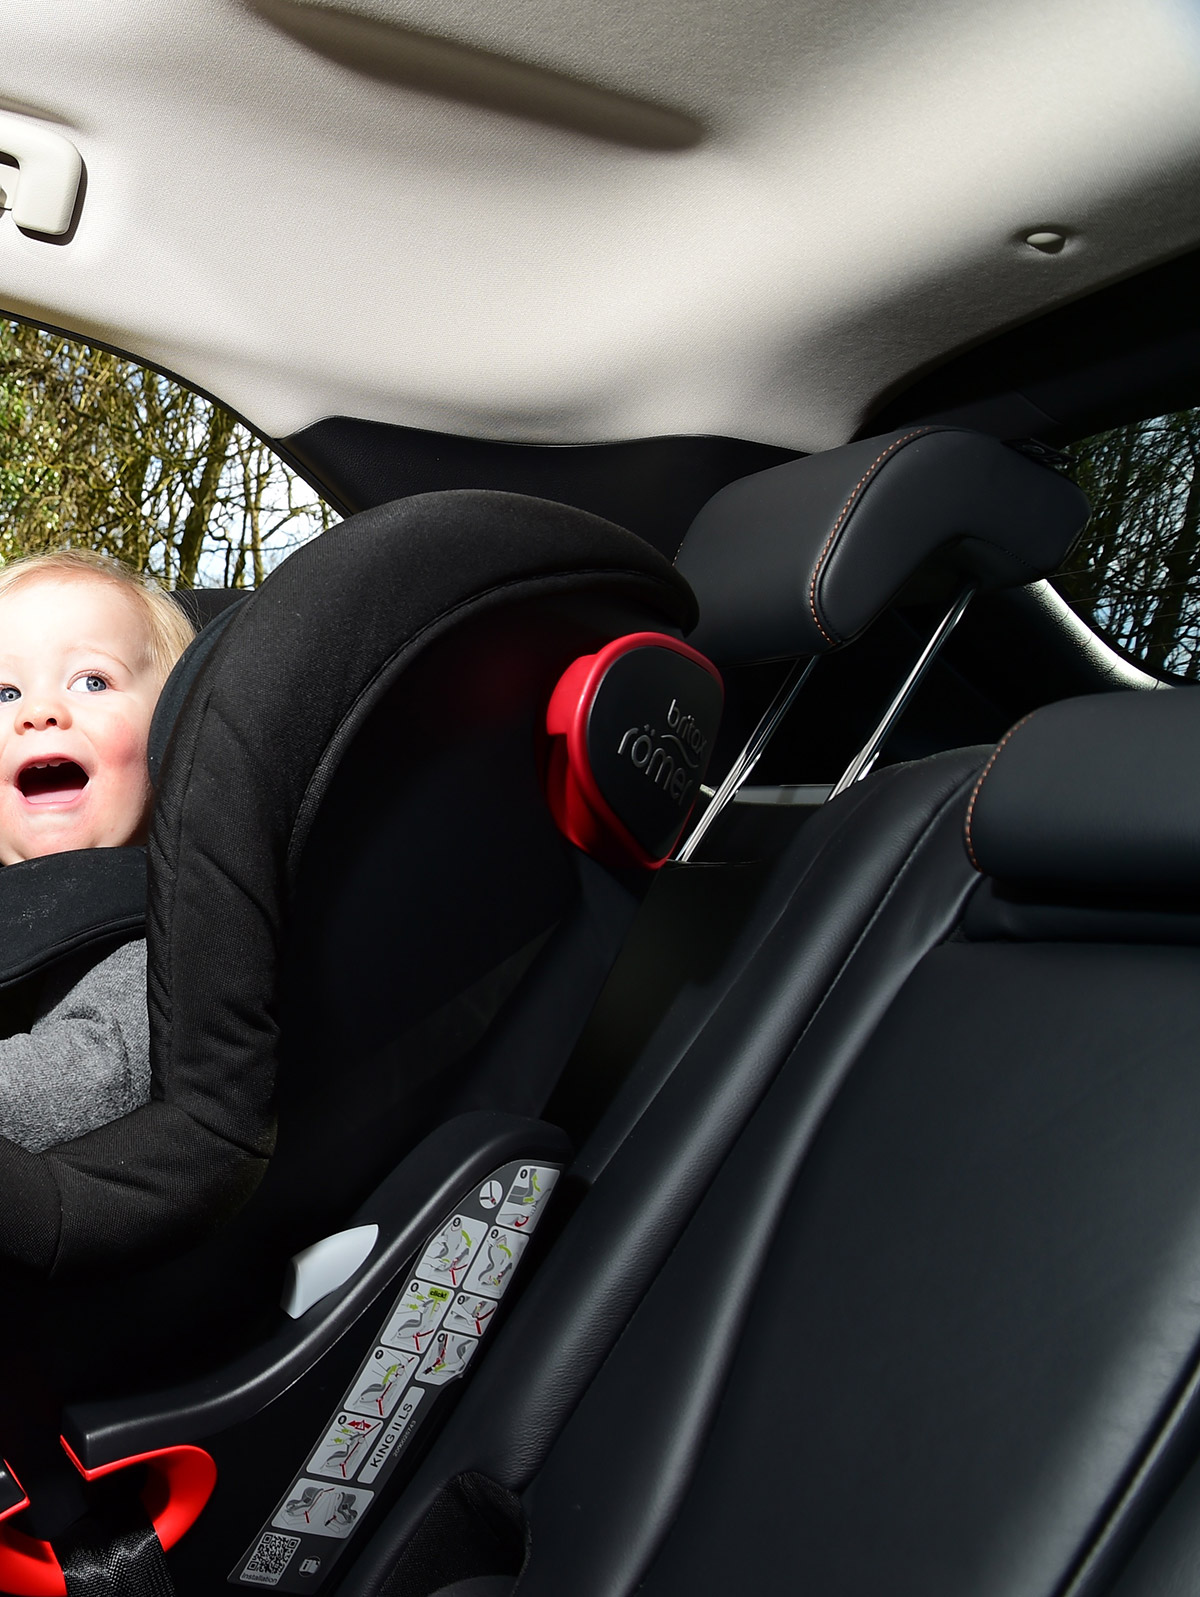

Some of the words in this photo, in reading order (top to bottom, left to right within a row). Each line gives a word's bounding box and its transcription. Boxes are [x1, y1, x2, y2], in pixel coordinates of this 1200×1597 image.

[667, 698, 707, 754] britax
[617, 724, 693, 806] römer
[429, 1290, 447, 1299] click!
[370, 1434, 395, 1468] KING
[391, 1422, 402, 1431] II
[398, 1403, 413, 1420] LS
